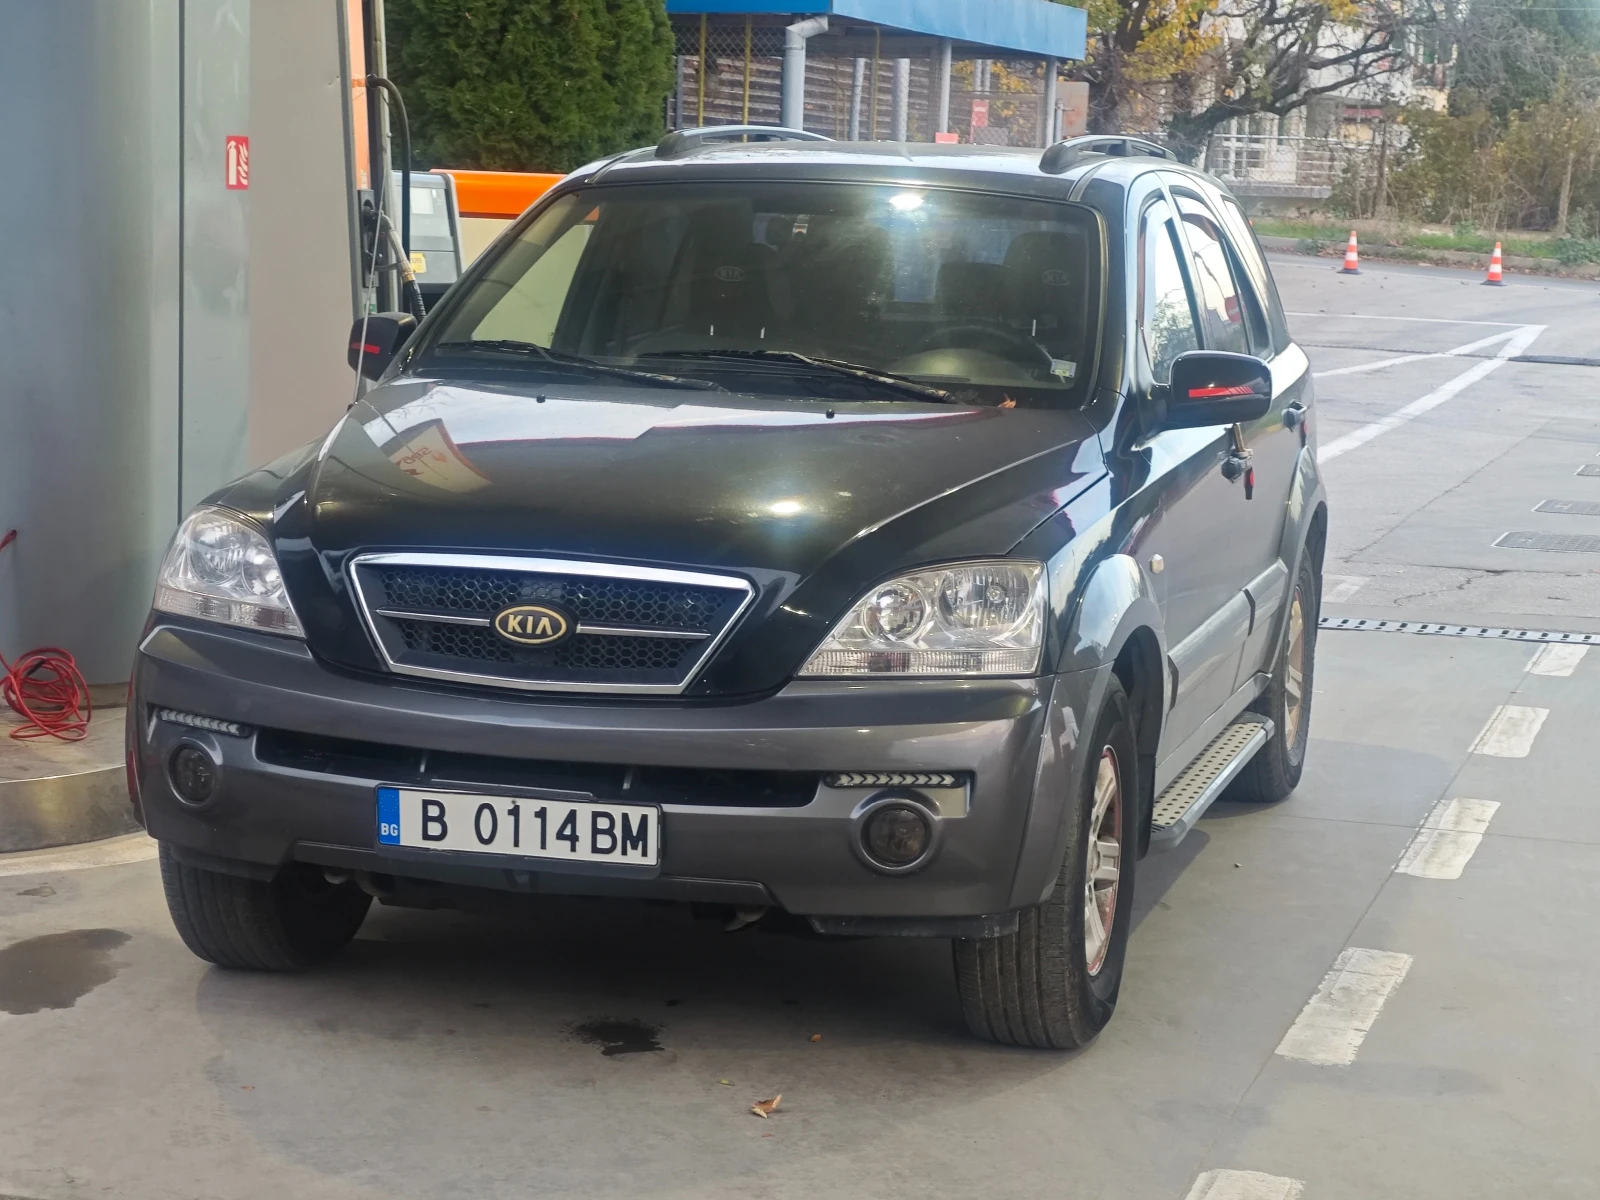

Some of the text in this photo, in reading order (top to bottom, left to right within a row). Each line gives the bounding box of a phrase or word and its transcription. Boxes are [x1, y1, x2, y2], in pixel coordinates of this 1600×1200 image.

[507, 614, 553, 636] KIA
[381, 822, 399, 837] BG
[421, 798, 448, 842] B
